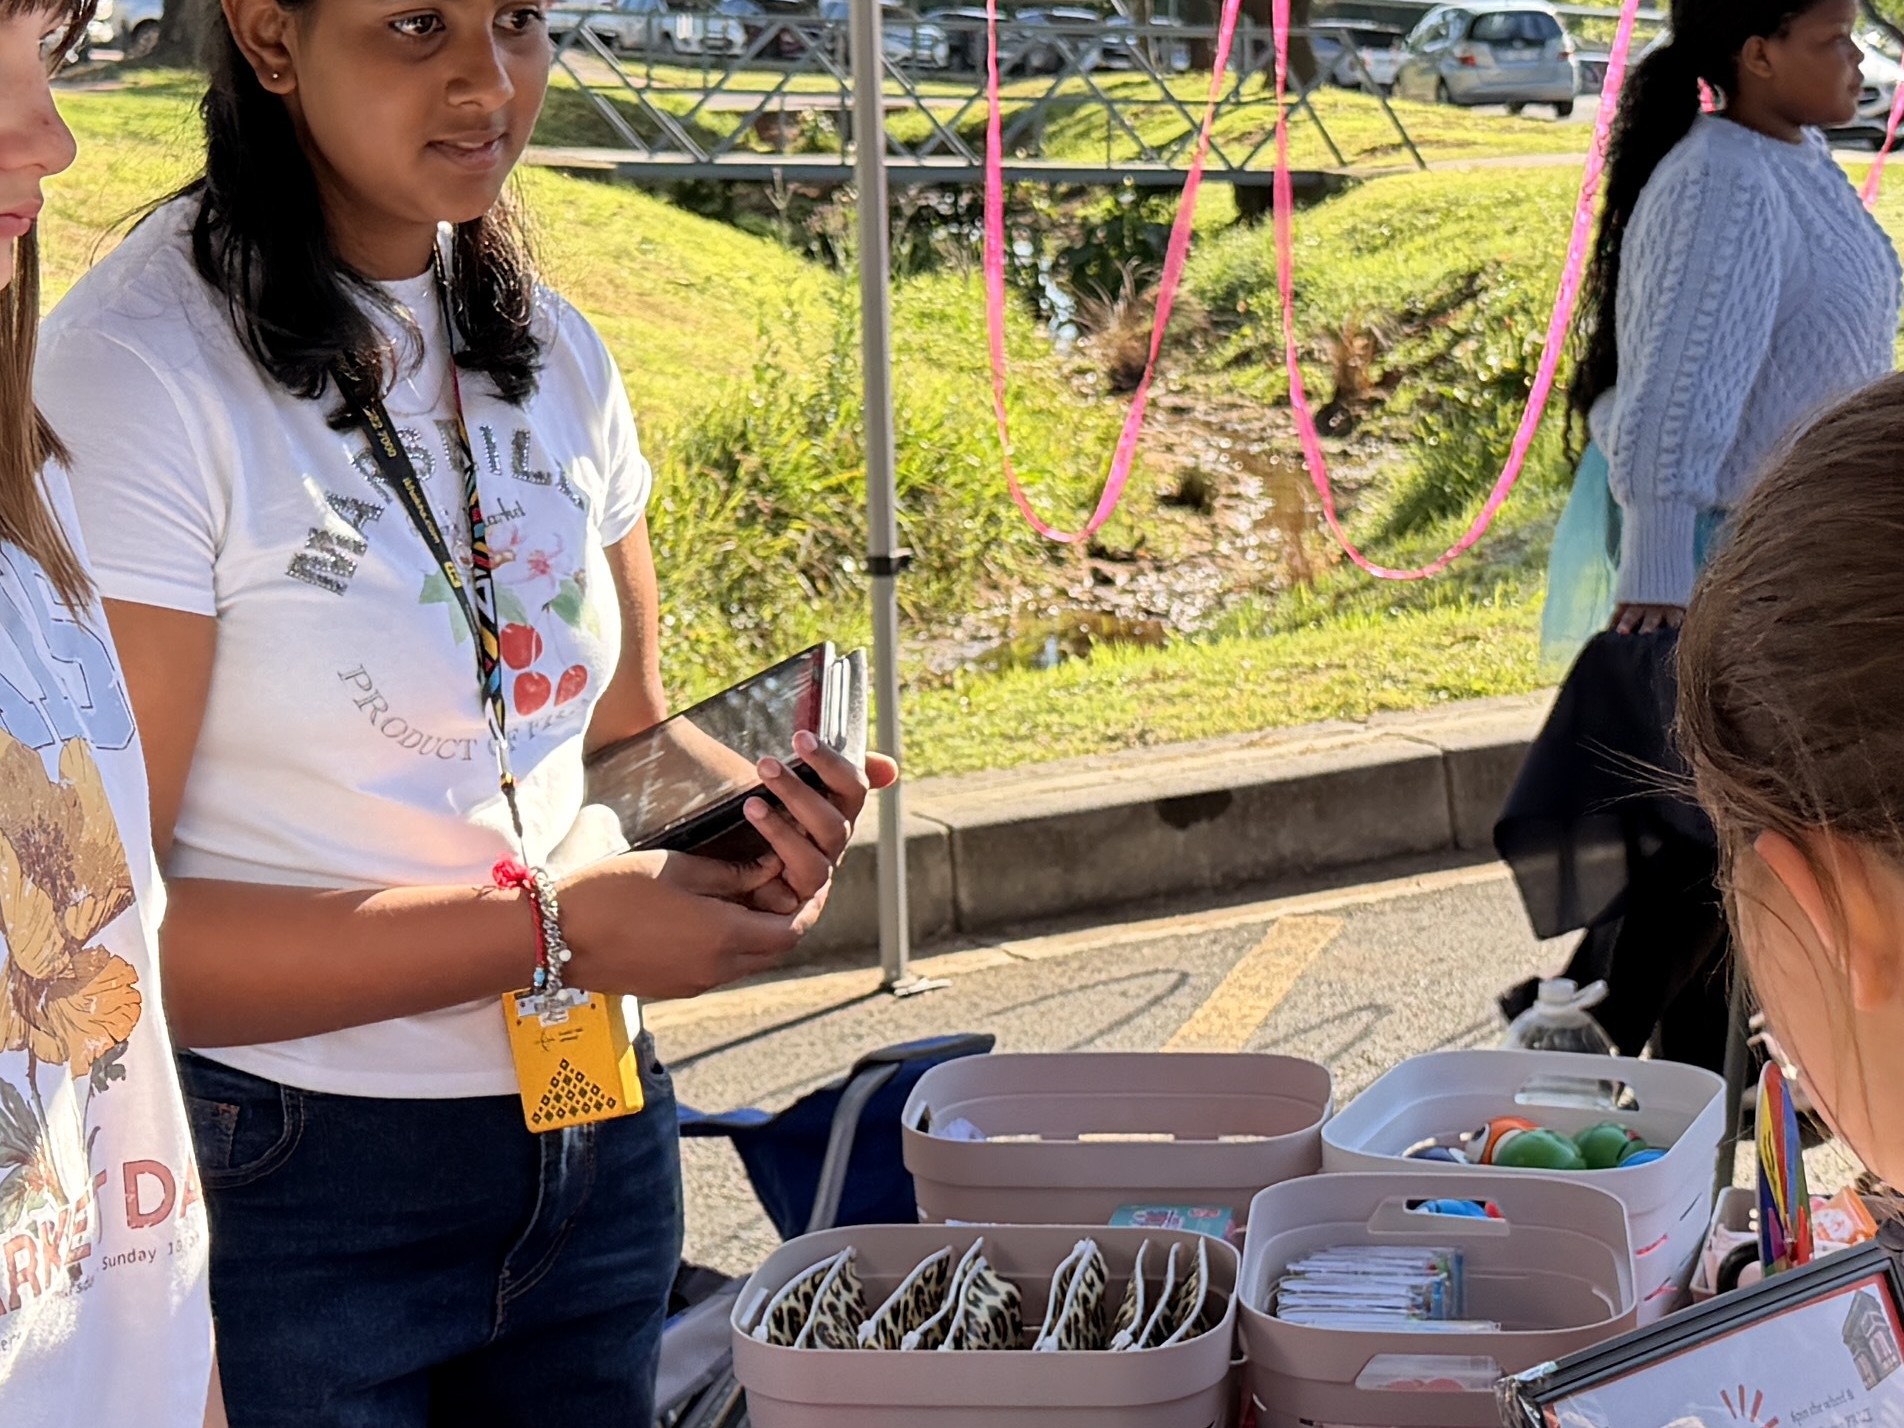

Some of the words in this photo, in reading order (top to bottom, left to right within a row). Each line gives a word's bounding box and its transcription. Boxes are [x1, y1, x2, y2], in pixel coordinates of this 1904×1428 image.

[286, 419, 586, 597] MARSIL
[337, 664, 478, 761] PRODUCT
[101, 1245, 159, 1271] Sunday
